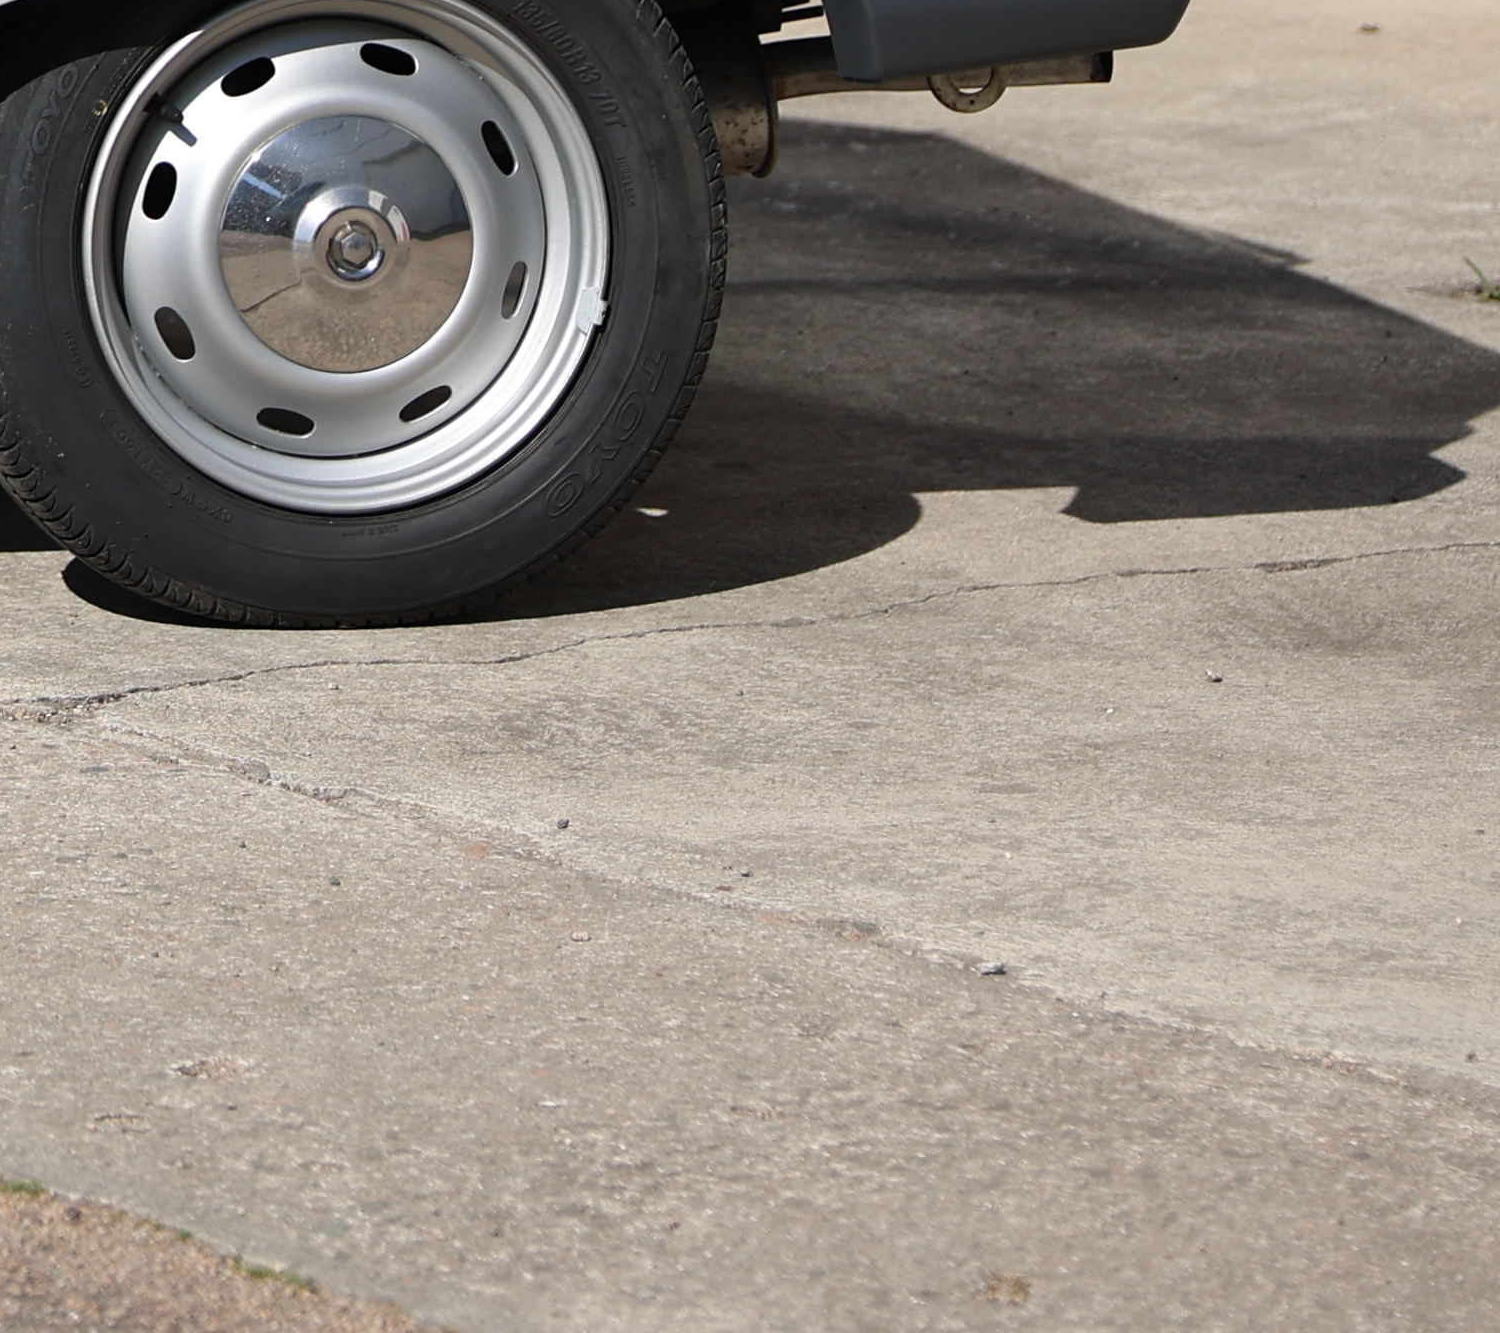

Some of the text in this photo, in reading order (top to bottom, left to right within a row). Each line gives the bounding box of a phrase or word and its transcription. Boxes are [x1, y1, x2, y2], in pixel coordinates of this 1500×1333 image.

[22, 63, 78, 181] TOYO
[589, 87, 628, 128] 70T
[546, 349, 669, 518] TOYO
